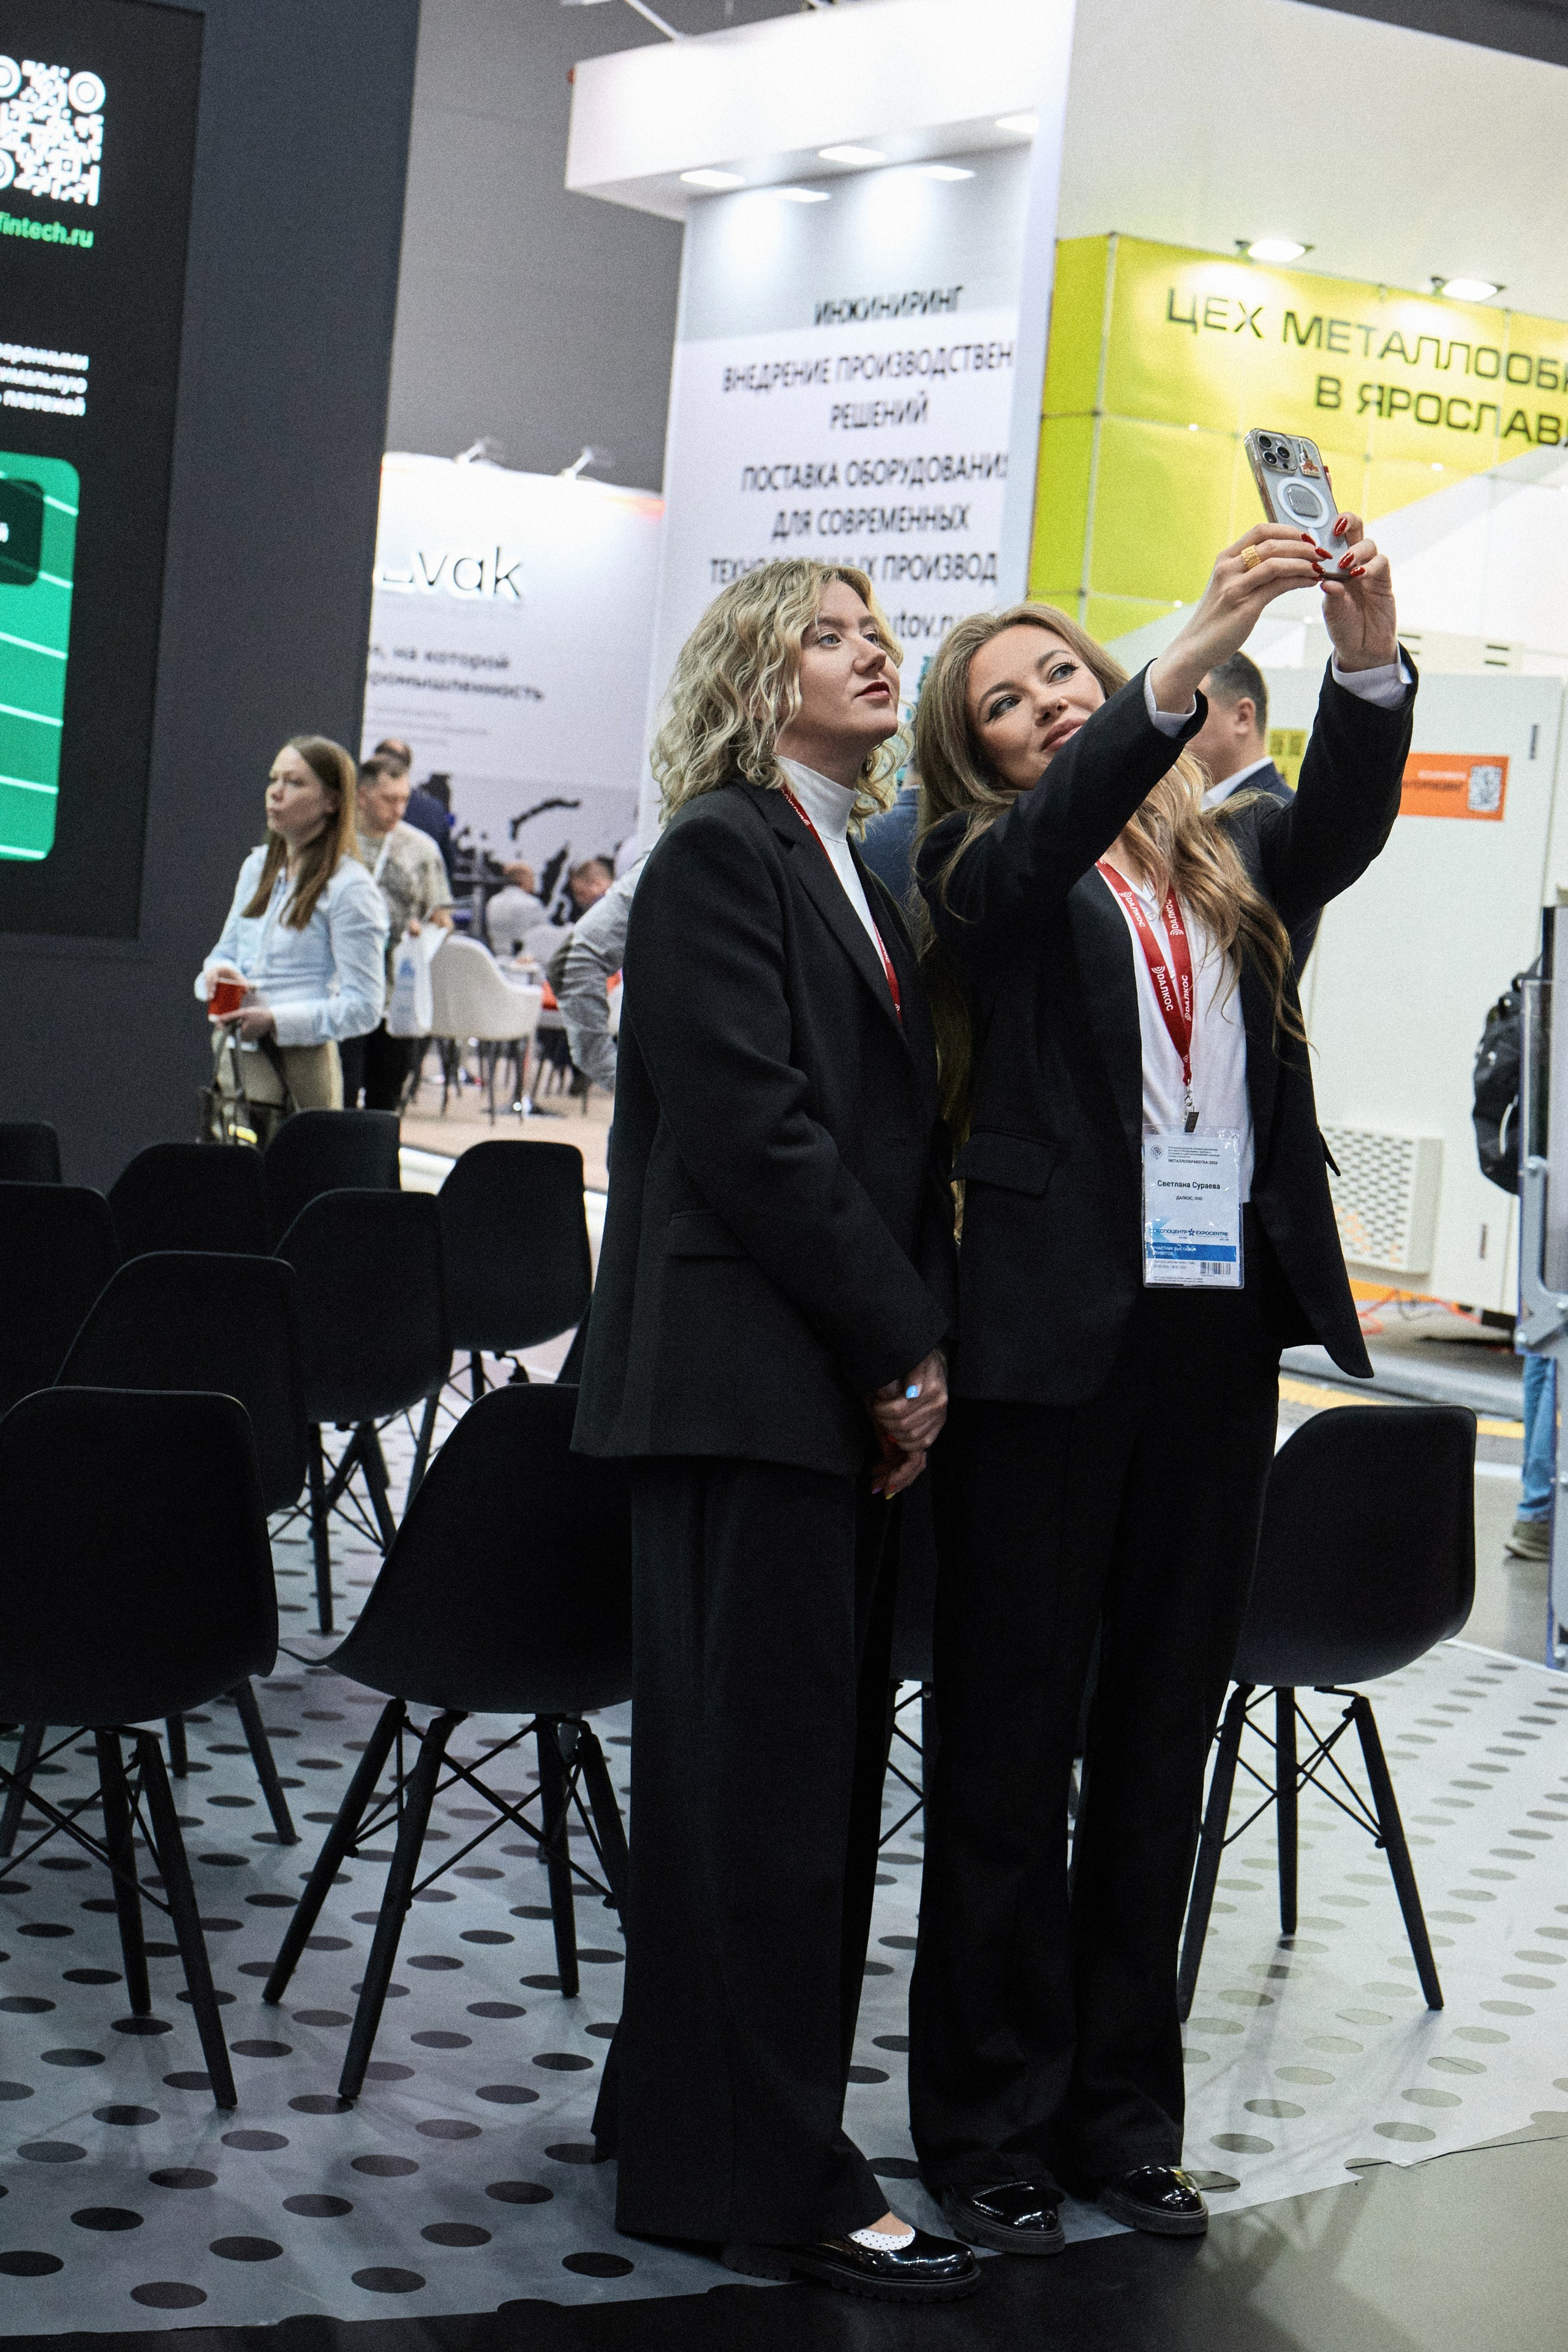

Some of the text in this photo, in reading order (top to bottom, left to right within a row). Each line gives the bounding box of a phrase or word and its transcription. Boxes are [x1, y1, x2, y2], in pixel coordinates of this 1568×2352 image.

[813, 285, 963, 326] ИНЖИНИРИНГ
[1166, 287, 1264, 339] ЦЕХ
[722, 356, 831, 395] ВНЕДРЕНИЕ
[830, 391, 929, 430] РЕШЕНИЙ
[1315, 375, 1568, 450] В ЯРОСЛАВ
[742, 462, 839, 492] ПОСТАВКА
[771, 503, 970, 541] ДЛЯ СОВРЕМЕННЫХ
[369, 673, 545, 703] ромышленность
